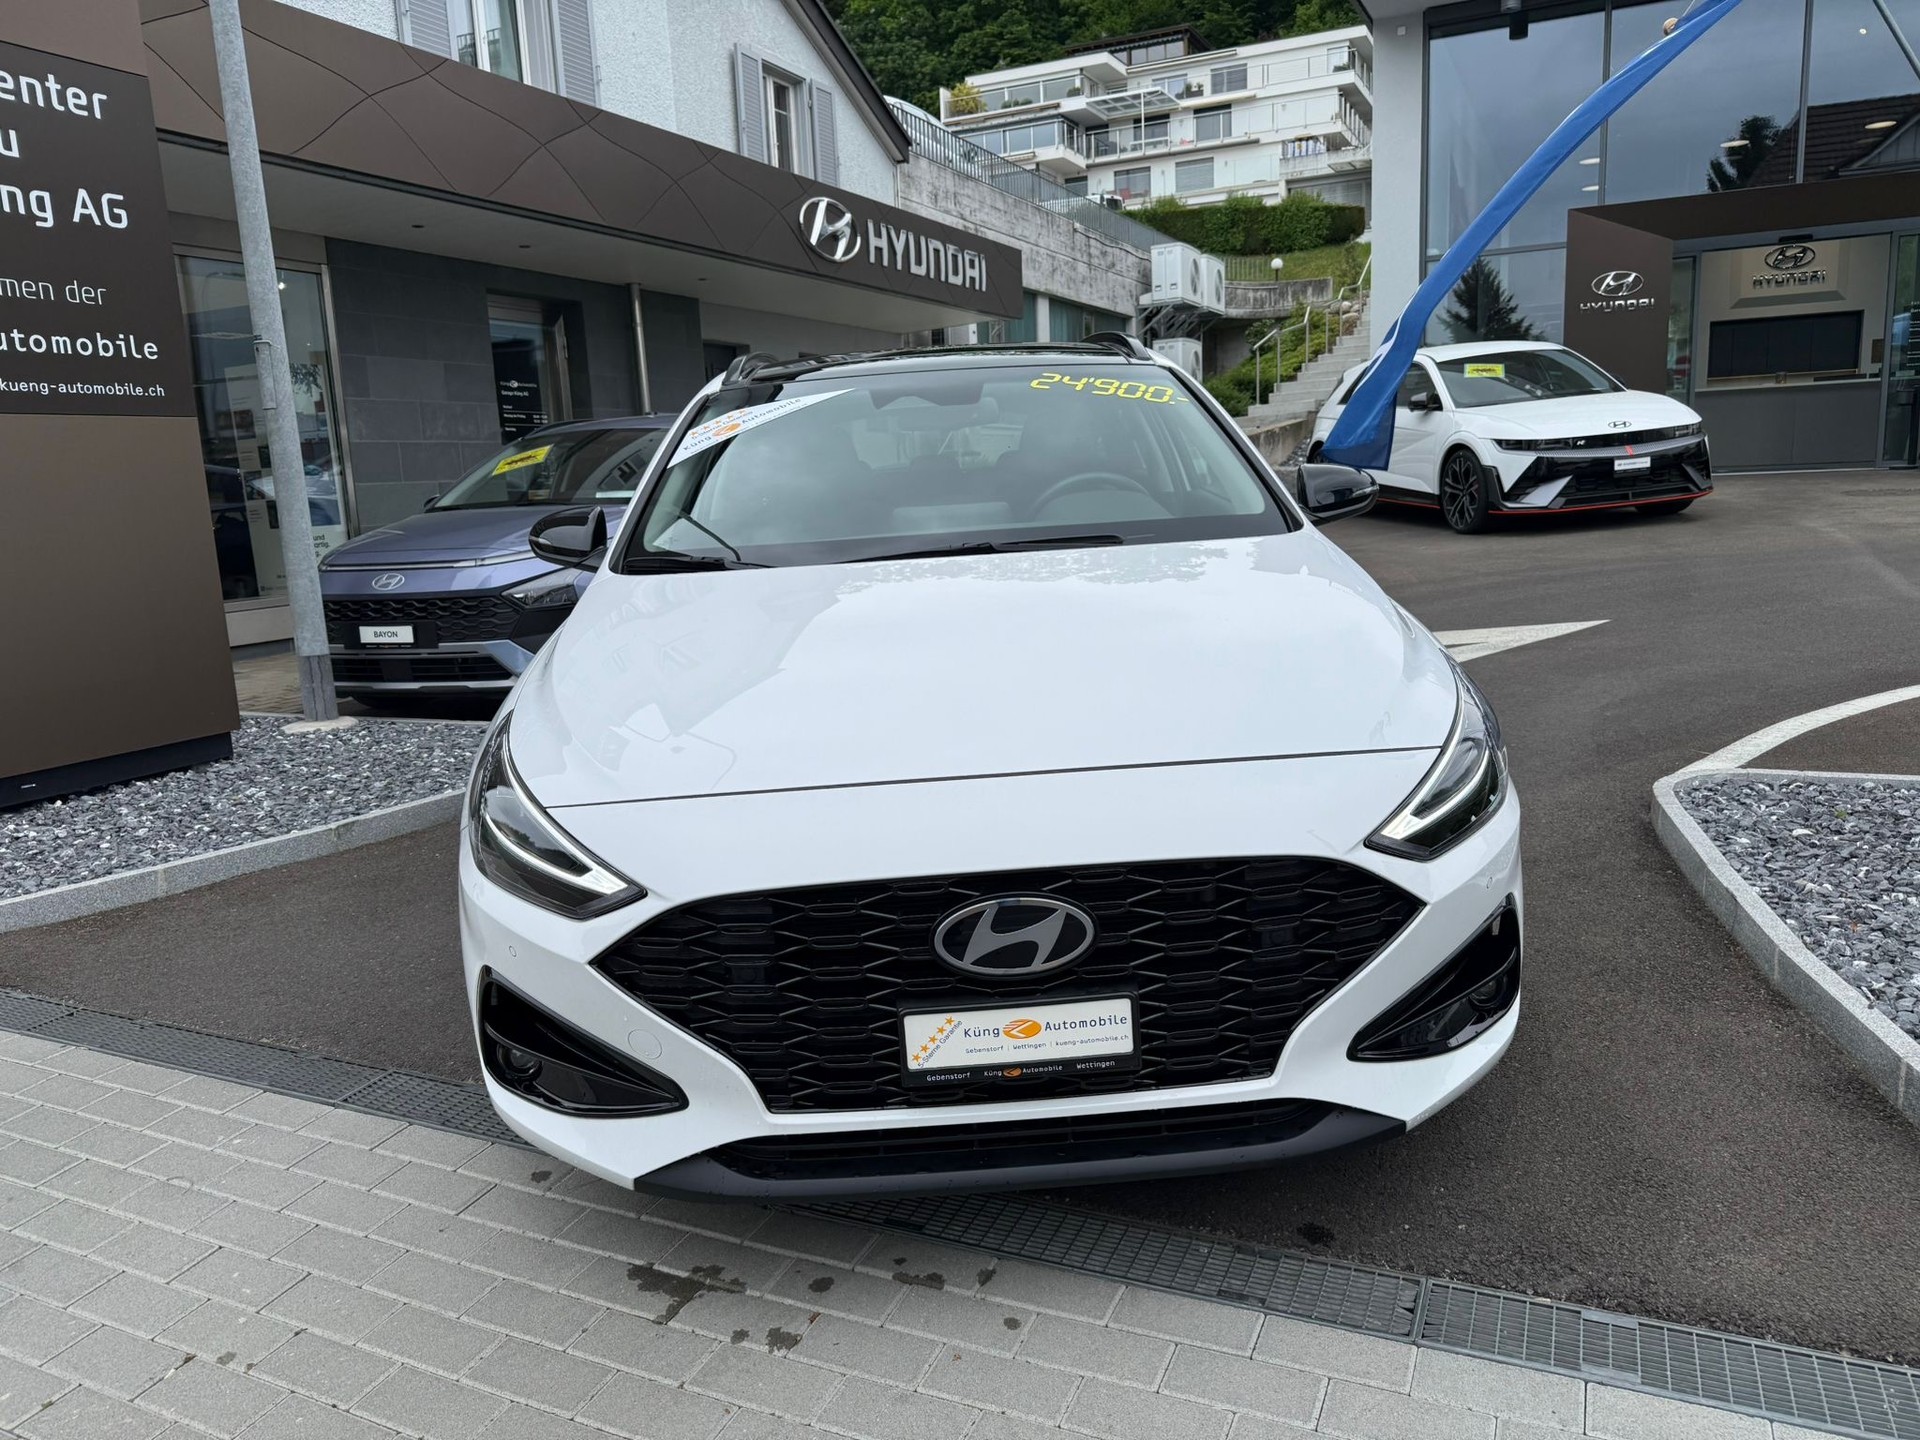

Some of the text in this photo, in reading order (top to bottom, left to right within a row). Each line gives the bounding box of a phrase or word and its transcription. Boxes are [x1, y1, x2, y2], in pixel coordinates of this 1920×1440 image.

[0, 69, 107, 120] enter
[0, 184, 128, 229] ng AG
[867, 218, 986, 292] HYUNDAI
[0, 278, 107, 305] men der
[1752, 270, 1826, 289] HYUNDAI
[1580, 298, 1655, 314] HYUNDAI
[0, 378, 165, 397] kueng-automobile.ch
[683, 398, 801, 451] Küng Automobile
[373, 630, 399, 639] BAYON
[963, 1014, 1128, 1039] Küng Automobile
[918, 1020, 963, 1068] 5-Sterne Garantie
[965, 1034, 1130, 1054] Gebenstorf Wettingen kueng-automobile.ch
[926, 1060, 1116, 1082] Gebenstorf Küng Automobile Wettingen
